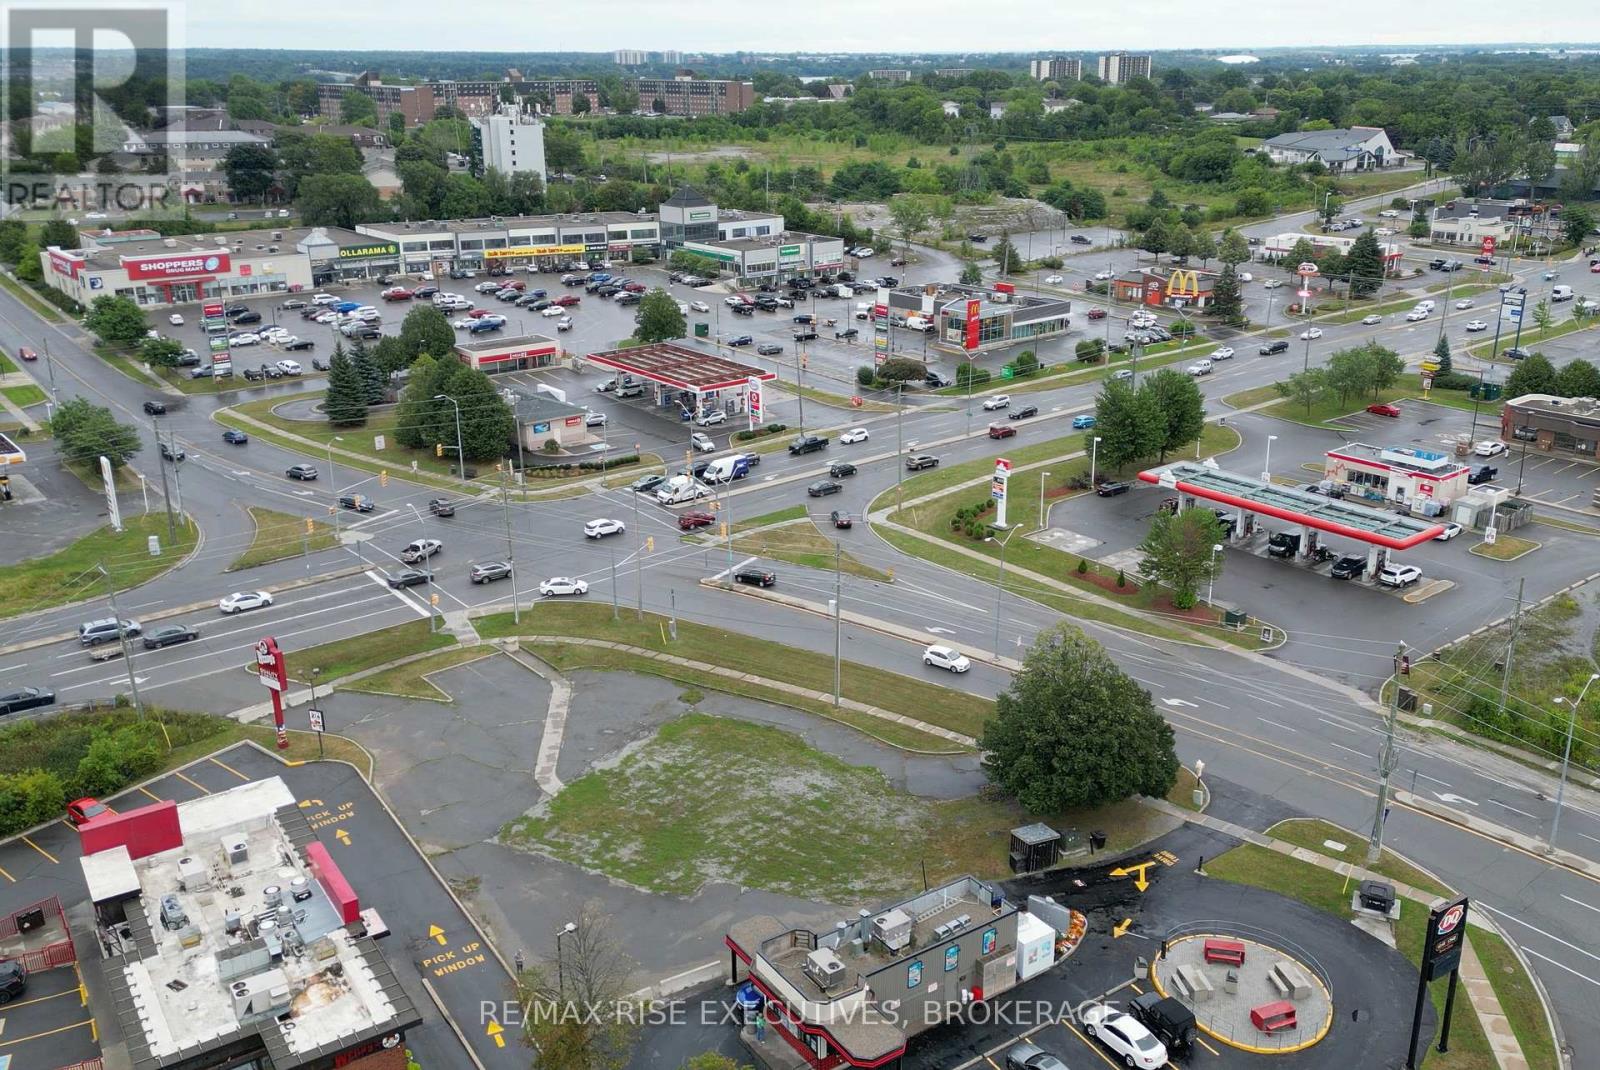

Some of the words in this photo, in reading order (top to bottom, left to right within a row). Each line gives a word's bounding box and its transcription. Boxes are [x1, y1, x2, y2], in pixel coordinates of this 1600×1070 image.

[339, 246, 387, 257] OLLARAMA
[139, 259, 204, 271] SHOPPERS
[185, 265, 204, 273] MART
[337, 802, 353, 811] UP
[310, 811, 354, 830] WINDOW
[423, 951, 456, 967] PICK
[462, 942, 480, 953] UP
[434, 954, 485, 976] WINDOW
